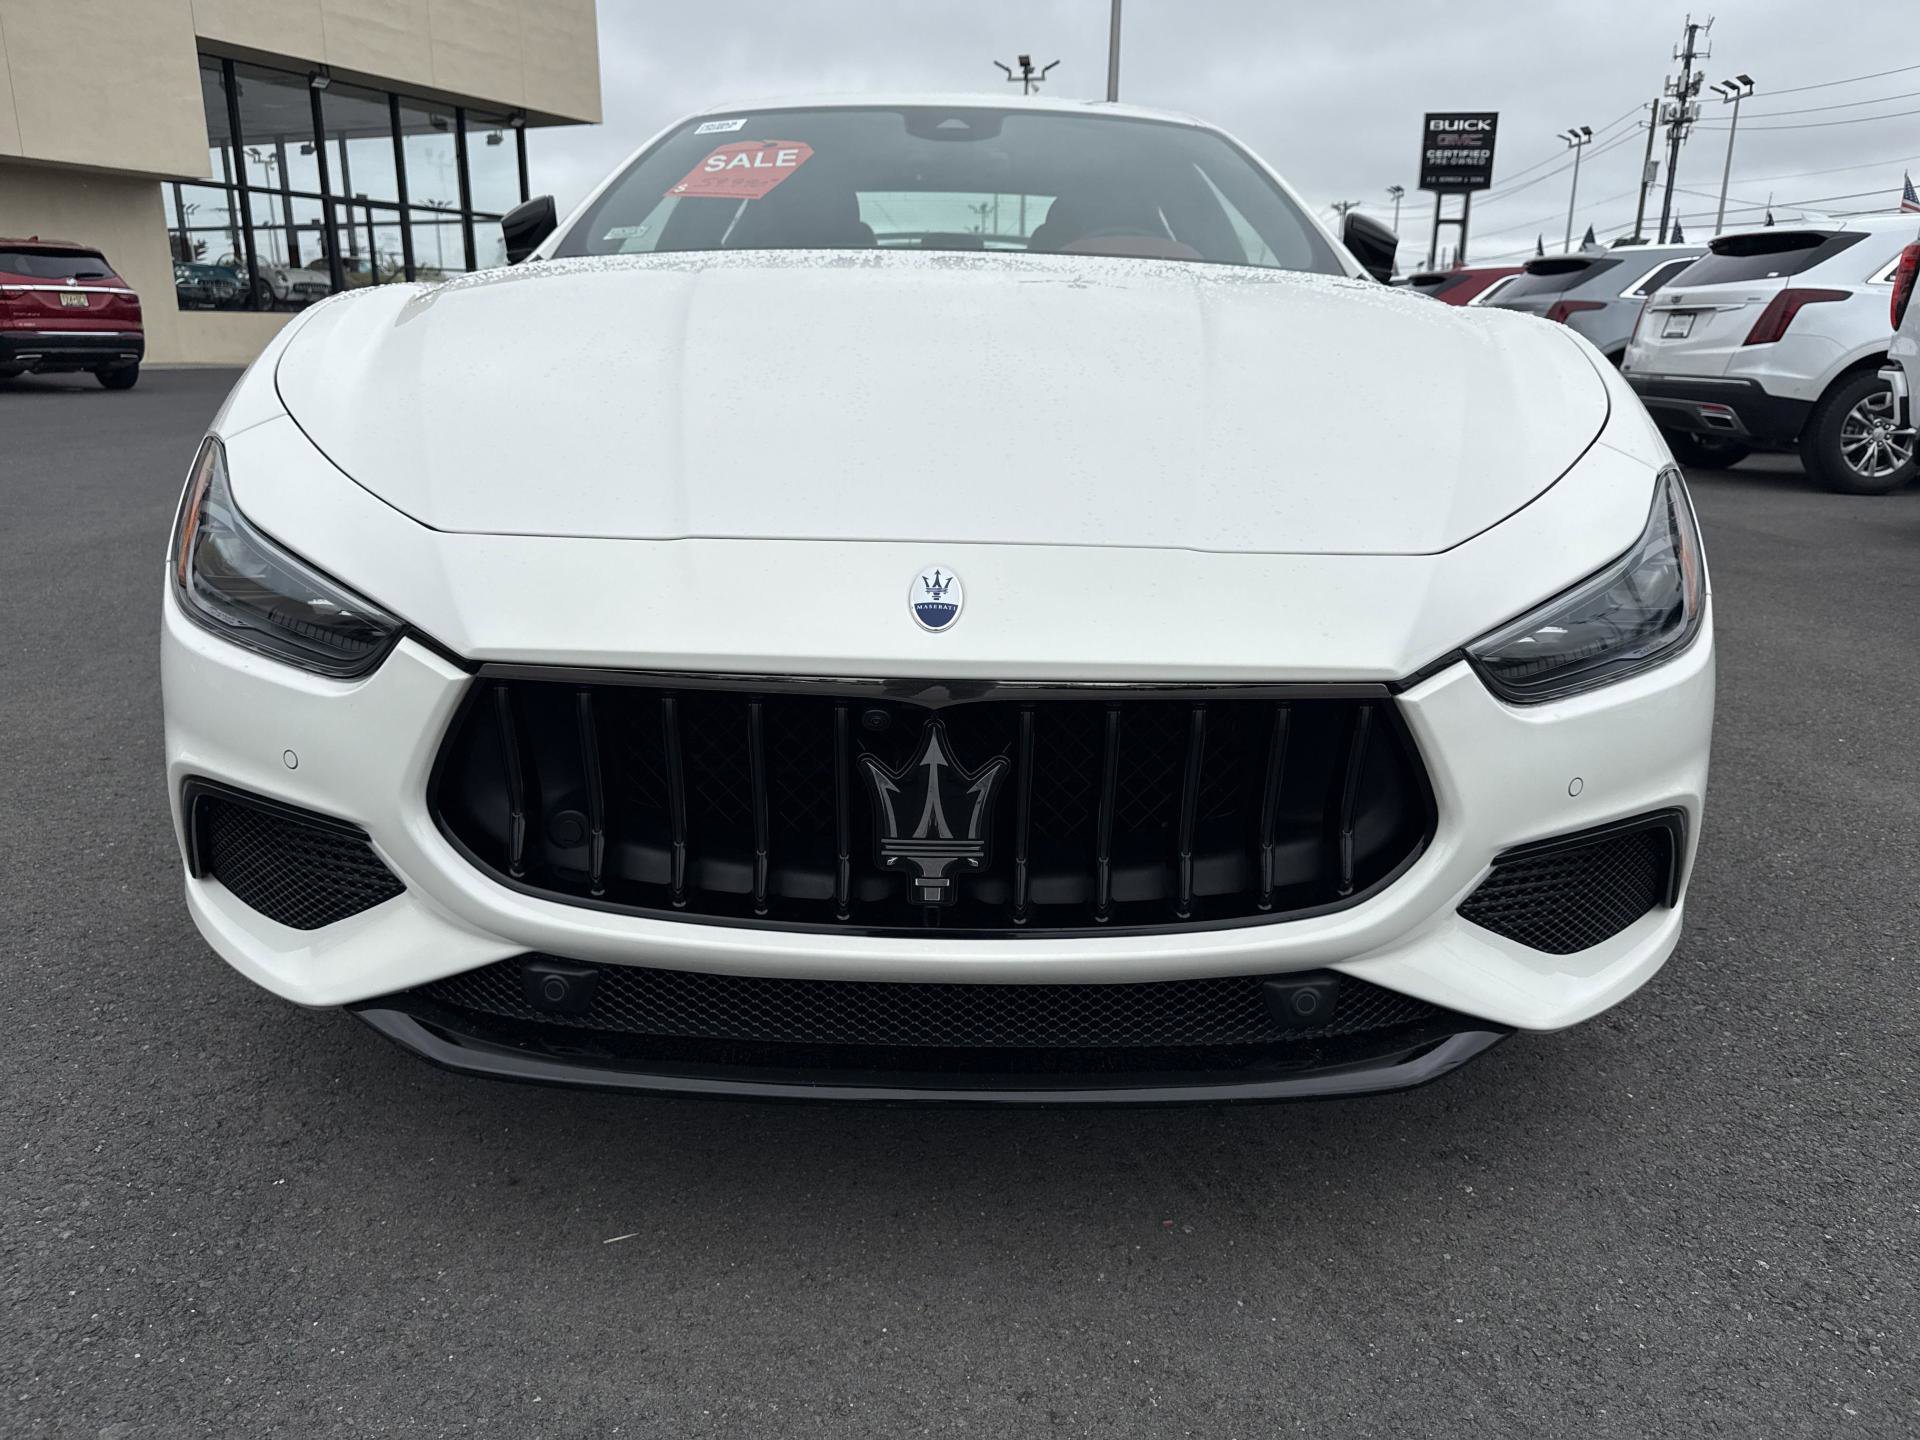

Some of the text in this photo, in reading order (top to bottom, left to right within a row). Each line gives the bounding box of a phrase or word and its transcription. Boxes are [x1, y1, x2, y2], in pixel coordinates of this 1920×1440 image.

[1429, 119, 1492, 131] BUICK
[1426, 149, 1491, 158] CERTIFIED
[704, 149, 799, 172] SALE
